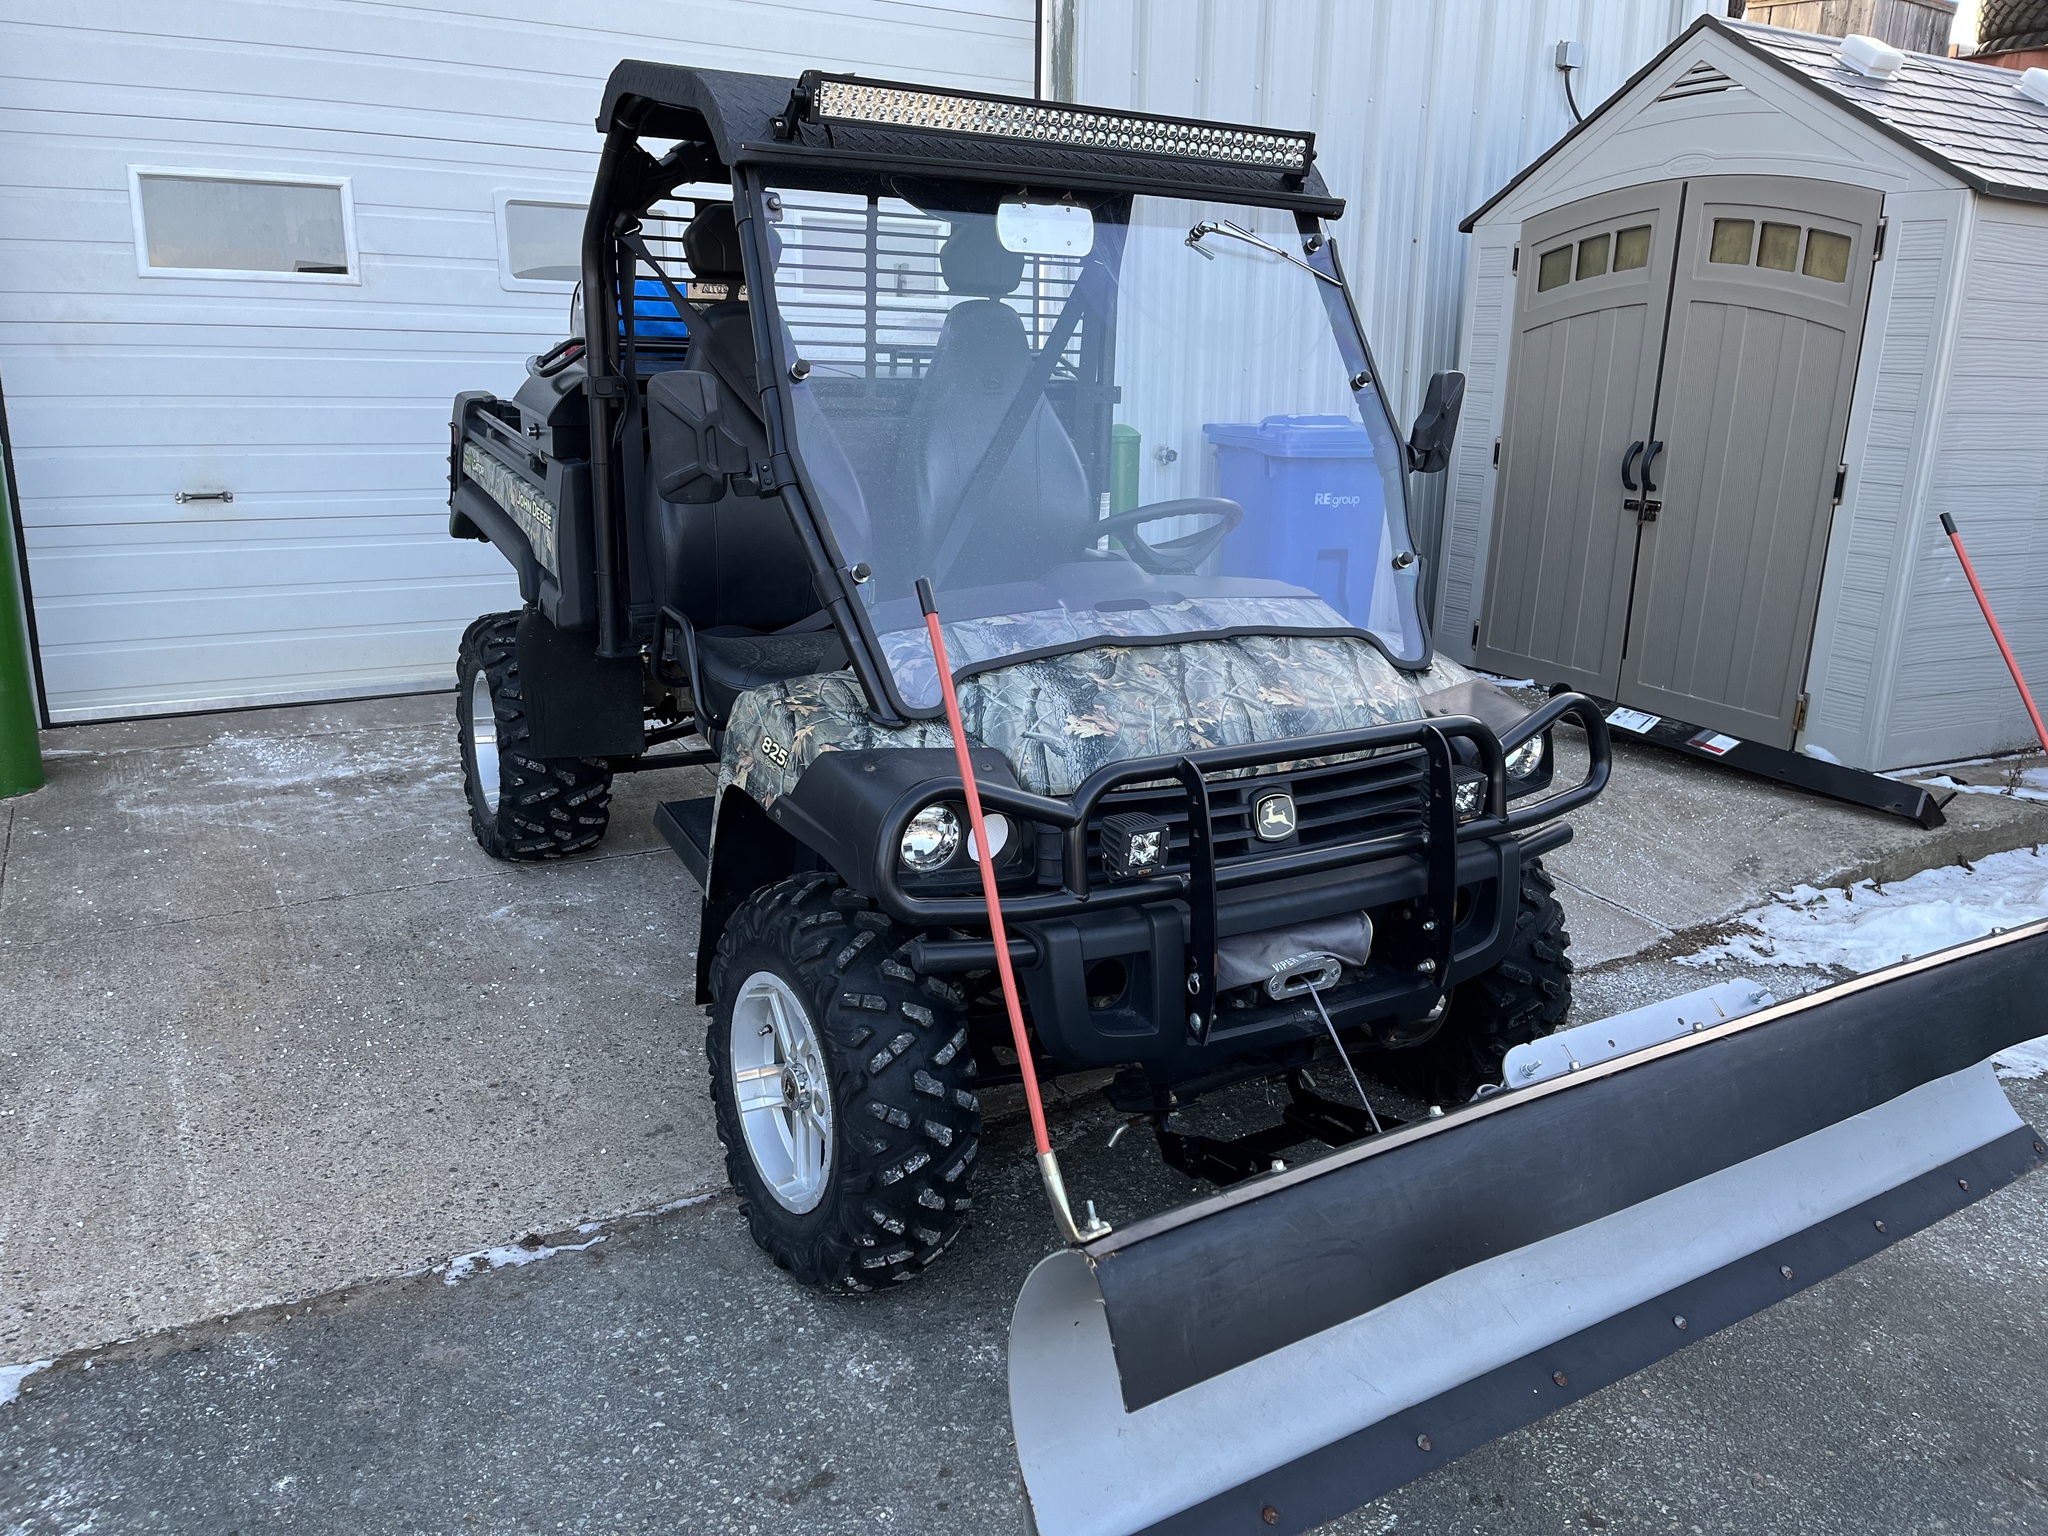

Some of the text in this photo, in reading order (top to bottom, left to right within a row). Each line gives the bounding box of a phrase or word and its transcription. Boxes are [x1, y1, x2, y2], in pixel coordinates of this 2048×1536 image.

[516, 489, 553, 530] JOHN DEERE
[761, 736, 789, 769] 825i
[1271, 957, 1299, 973] VIPER
